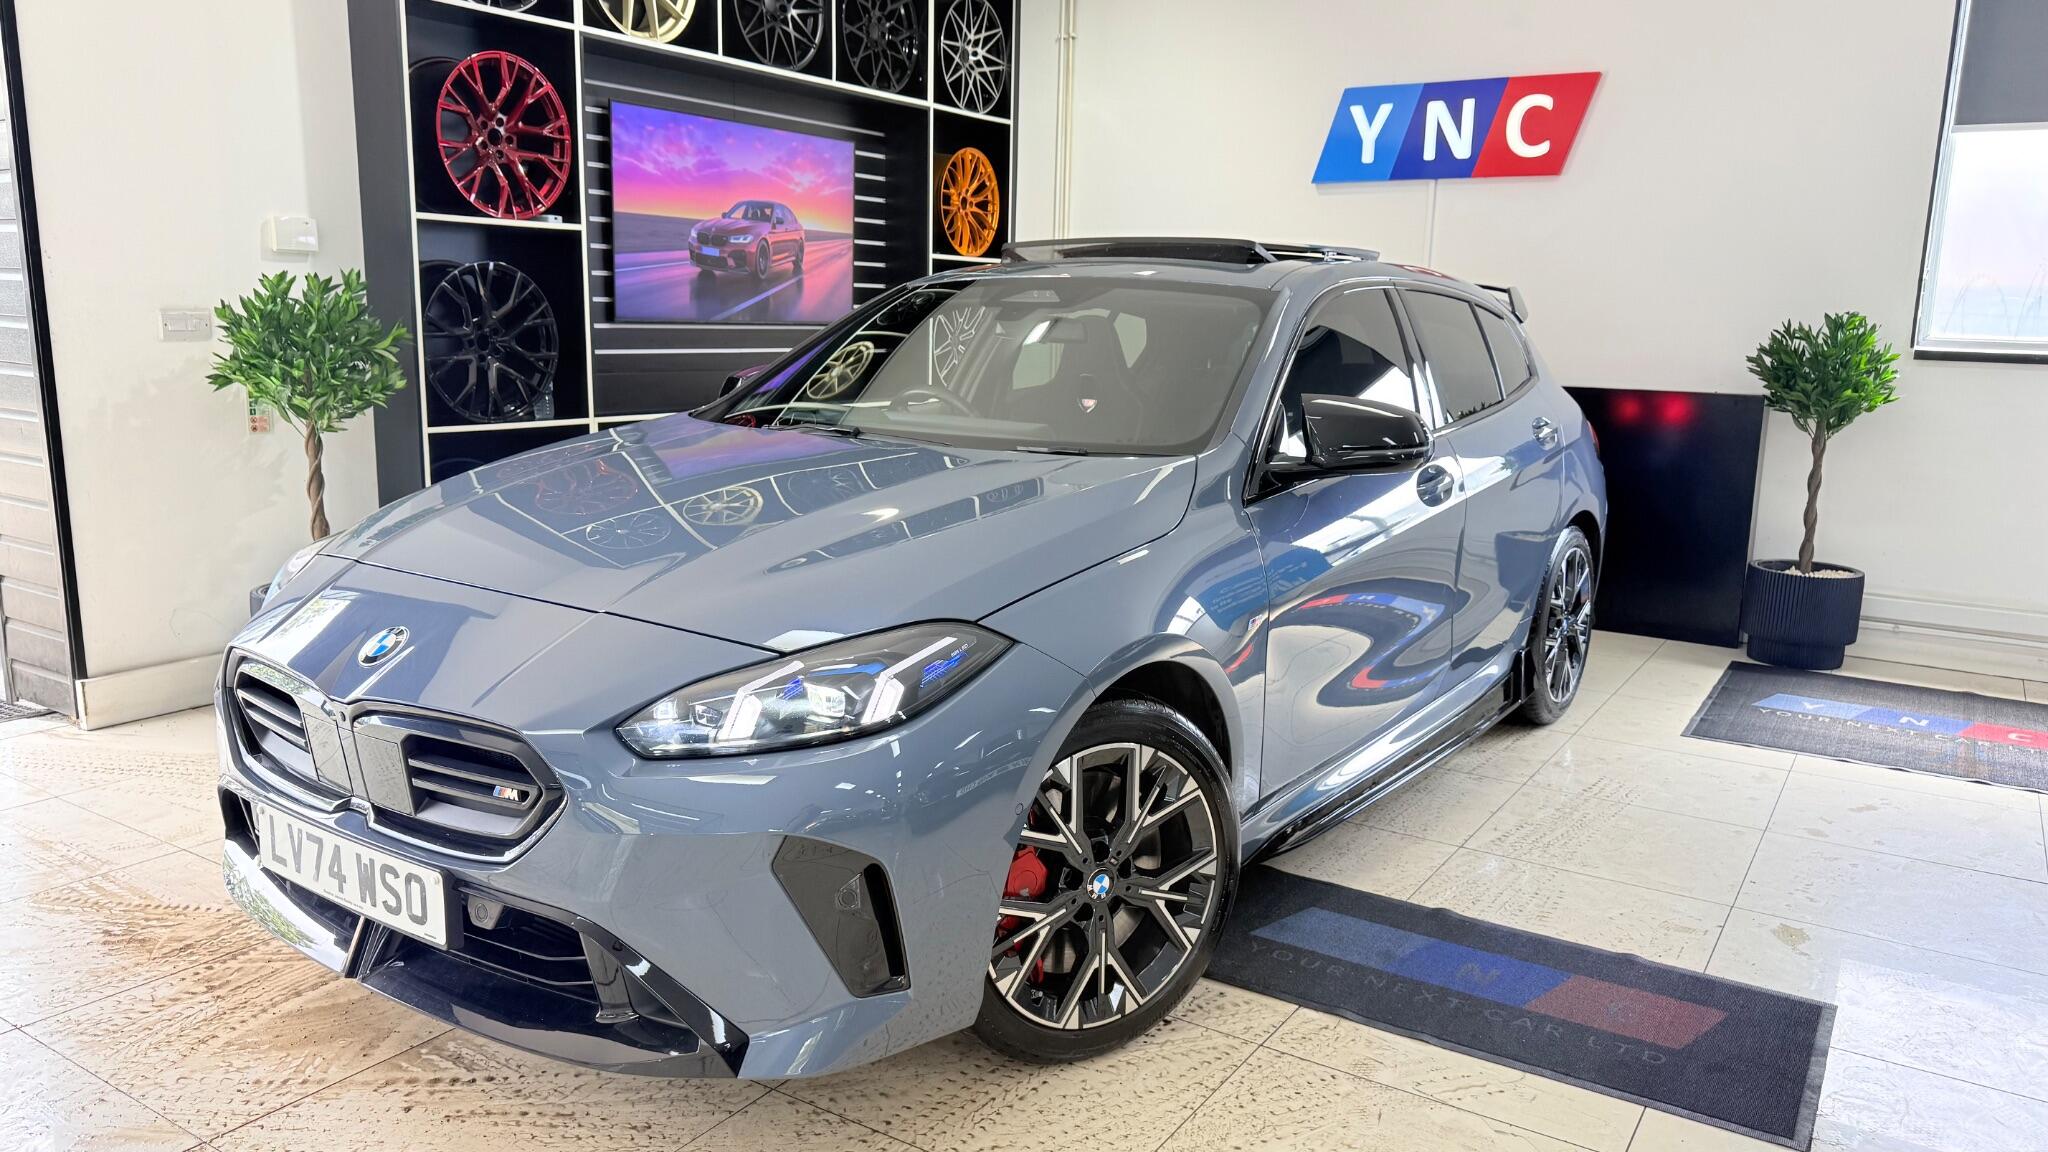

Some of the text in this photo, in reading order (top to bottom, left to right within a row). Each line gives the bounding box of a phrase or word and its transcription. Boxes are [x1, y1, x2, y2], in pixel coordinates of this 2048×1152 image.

[1349, 93, 1554, 164] YNC
[1759, 708, 1831, 723] YOUR
[1846, 720, 1919, 736] NEXT
[2008, 745, 2048, 754] LT
[269, 814, 428, 926] LV74 WSO
[1249, 940, 1667, 1065] YOUR NEXT CAR LTD
